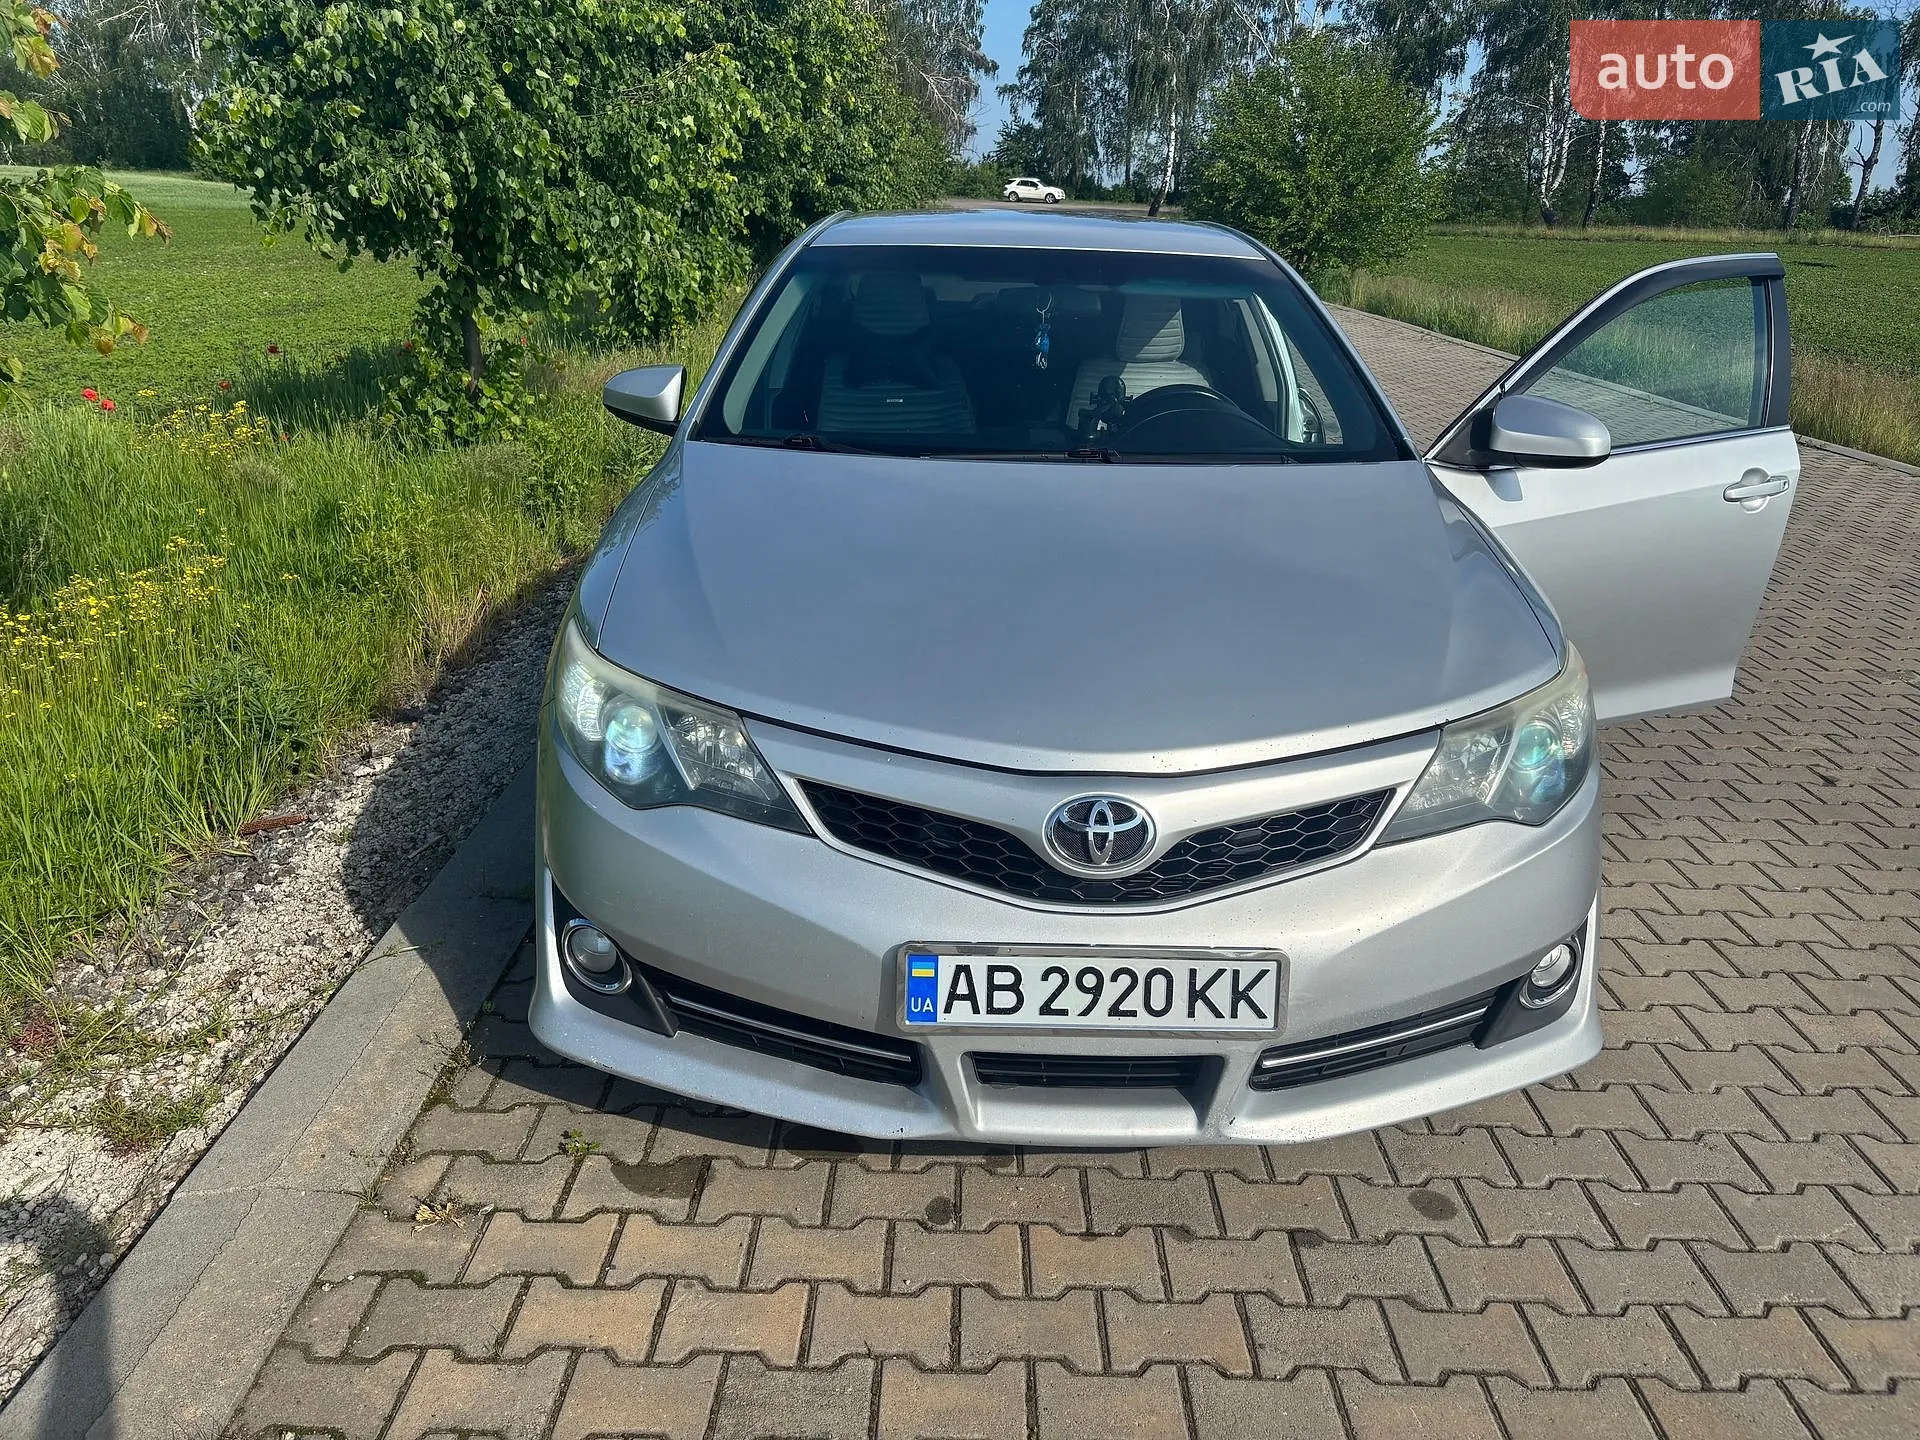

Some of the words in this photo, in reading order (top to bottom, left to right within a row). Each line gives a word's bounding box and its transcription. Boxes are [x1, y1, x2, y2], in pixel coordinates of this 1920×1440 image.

[911, 996, 934, 1013] UA
[943, 964, 1024, 1015] AB
[1039, 965, 1174, 1018] 2920
[1187, 967, 1271, 1019] KK
